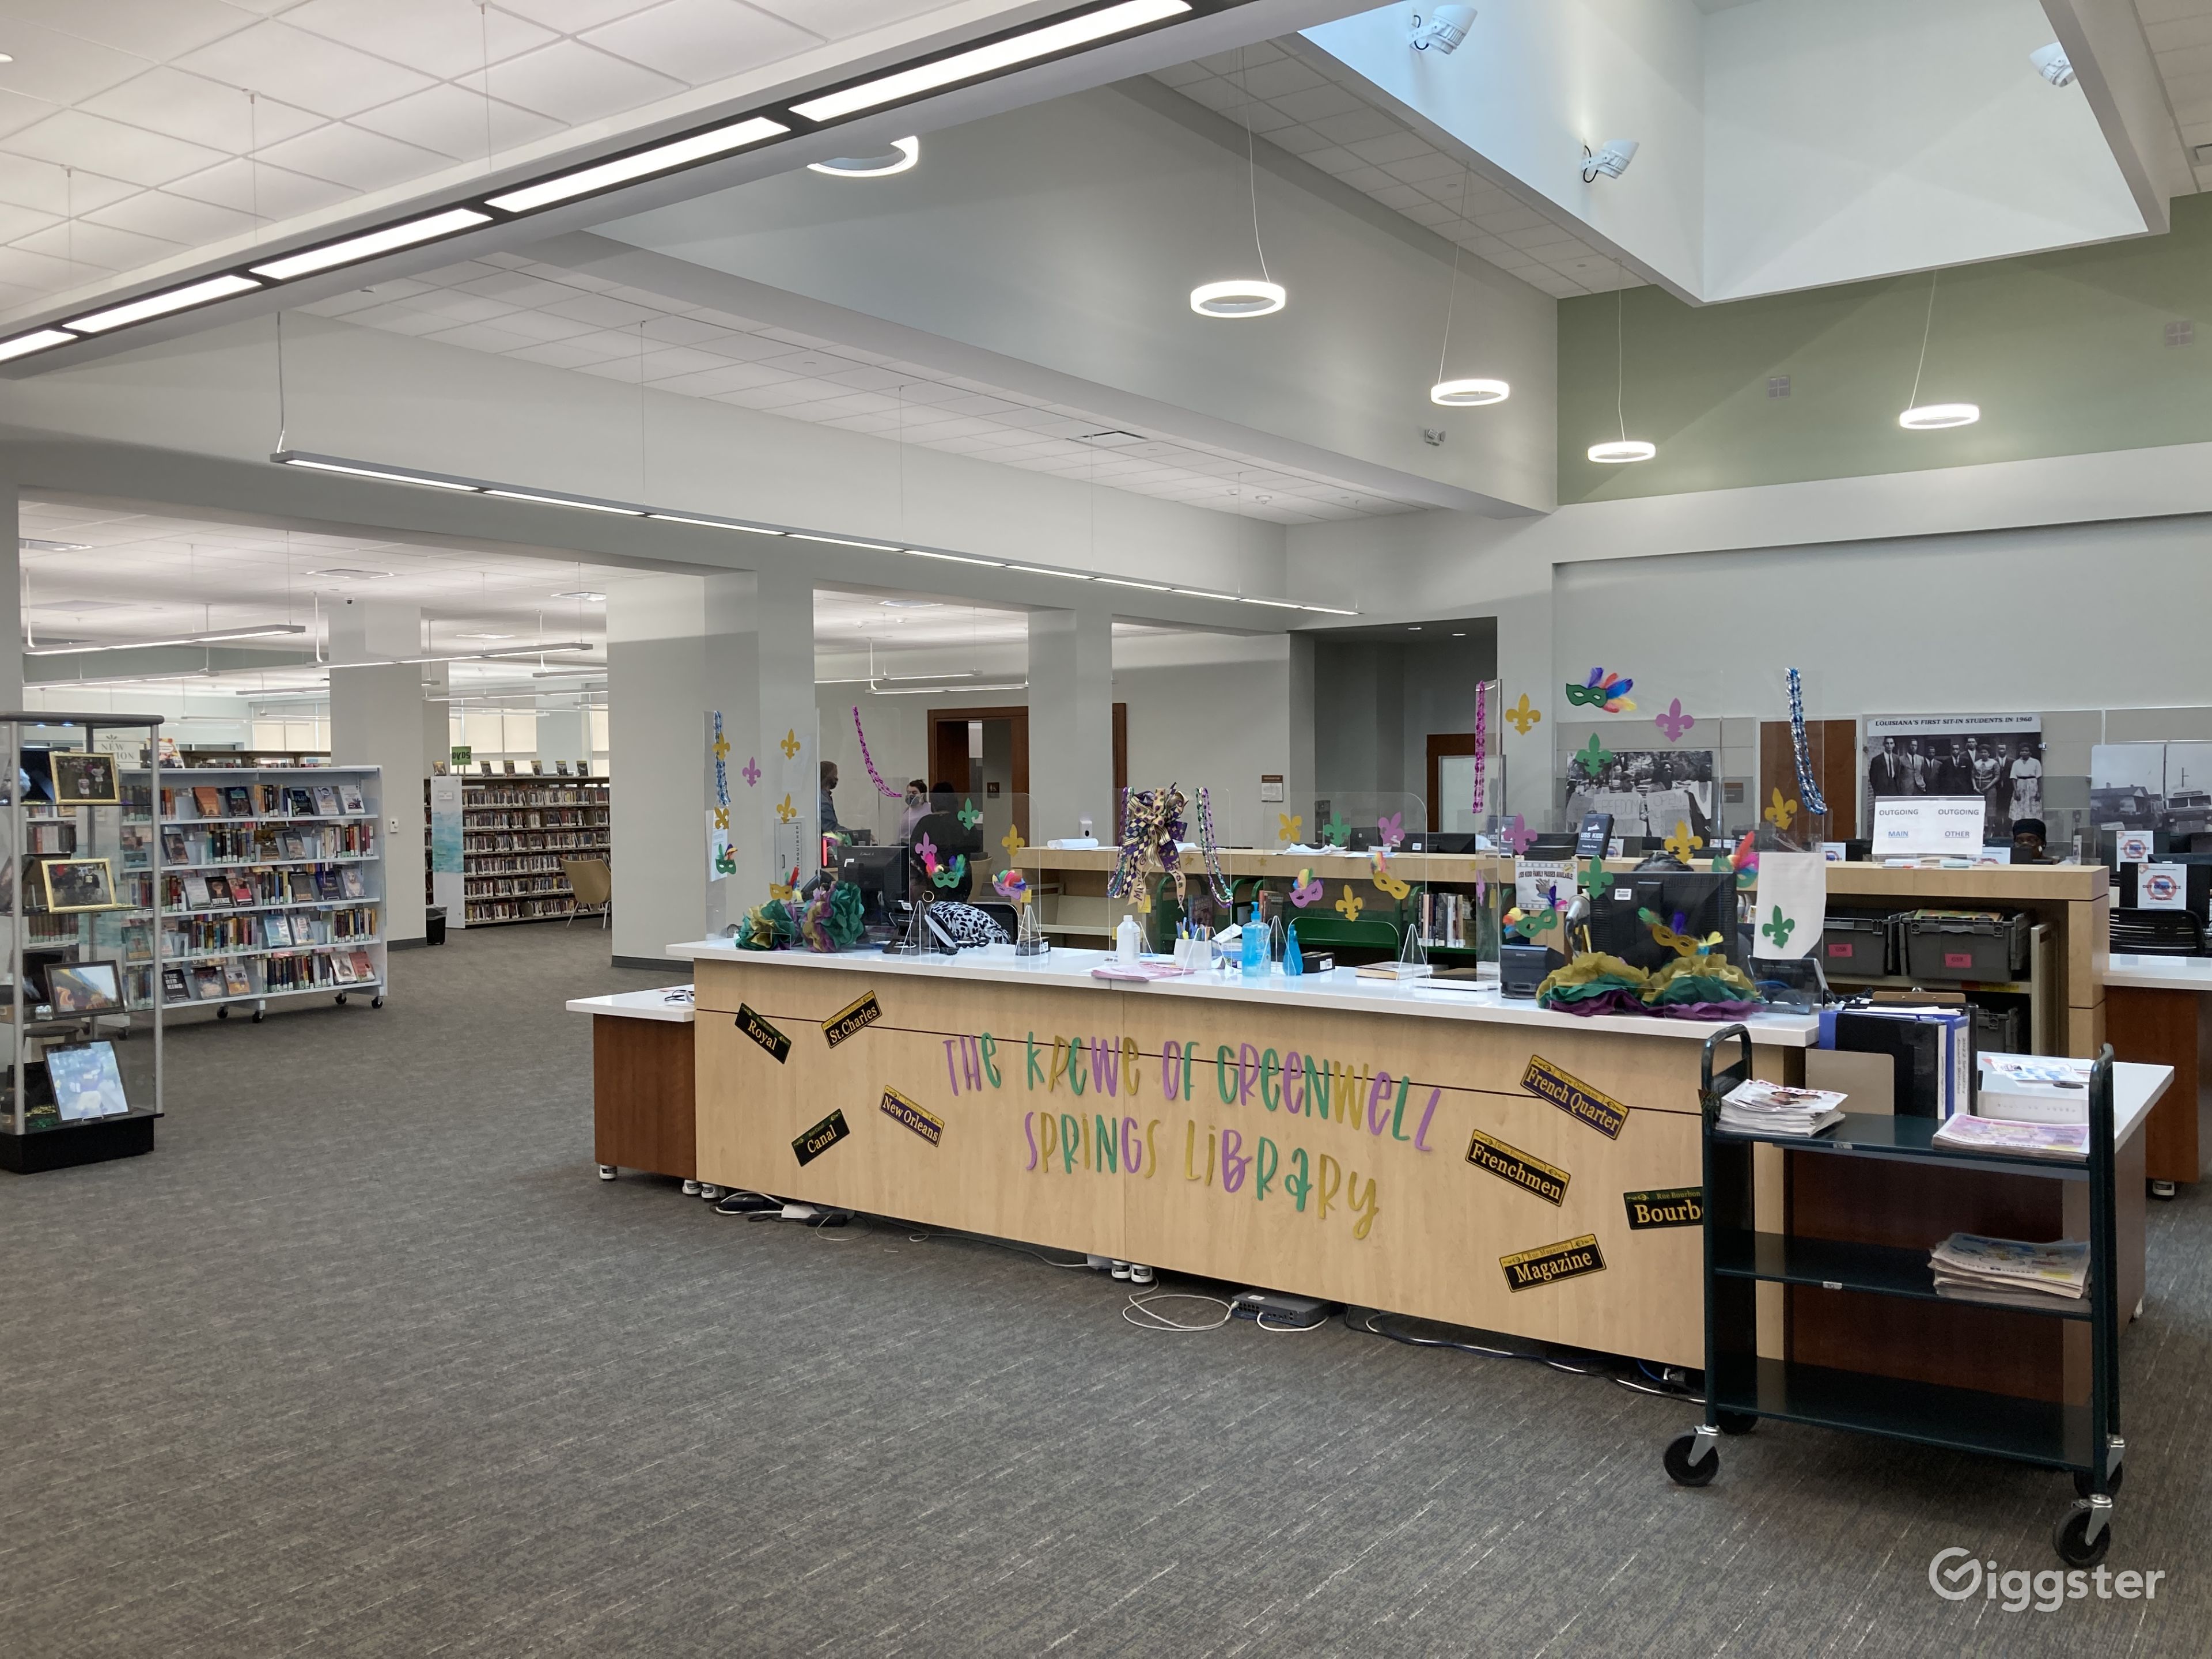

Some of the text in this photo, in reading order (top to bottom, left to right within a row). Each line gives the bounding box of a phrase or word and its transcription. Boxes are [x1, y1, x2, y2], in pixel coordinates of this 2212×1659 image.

[452, 752, 471, 760] DVDS
[748, 1019, 777, 1051] Royal
[1162, 1041, 1200, 1101] OF
[1526, 1066, 1620, 1132] French Quarter
[1559, 1073, 1599, 1100] New Orleans
[882, 1095, 938, 1142] New Orleans
[807, 1124, 837, 1153] Canal
[1471, 1142, 1562, 1200] Frenchmen
[1671, 1191, 1701, 1199] Bourbon
[1634, 1199, 1703, 1224] Bourb
[1540, 1244, 1569, 1255] Magazine
[1514, 1252, 1593, 1283] Magazine
